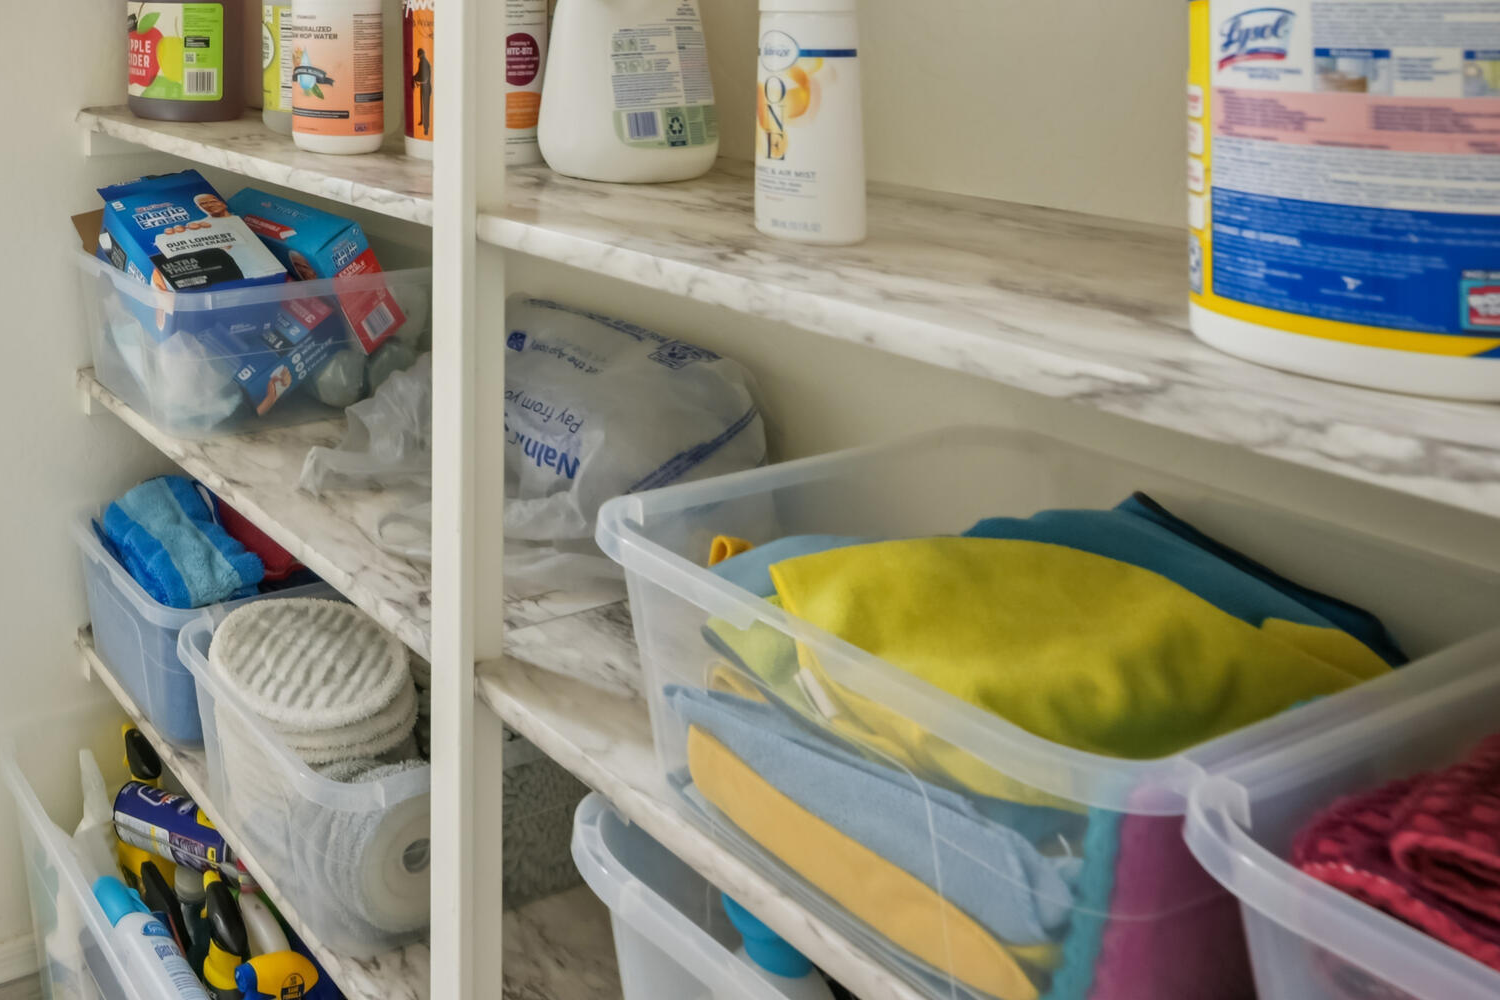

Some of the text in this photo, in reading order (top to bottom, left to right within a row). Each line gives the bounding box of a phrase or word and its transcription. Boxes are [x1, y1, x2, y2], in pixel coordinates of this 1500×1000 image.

[1220, 14, 1289, 53] Lysol
[129, 38, 152, 53] PPLE
[134, 206, 186, 222] Magic
[140, 213, 190, 230] Eraser
[166, 232, 233, 249] OUR LONGEST
[206, 237, 237, 248] ERASER
[161, 257, 199, 270] ULTRA
[165, 263, 201, 275] THICK
[520, 396, 555, 423] from
[555, 407, 584, 434] Pay
